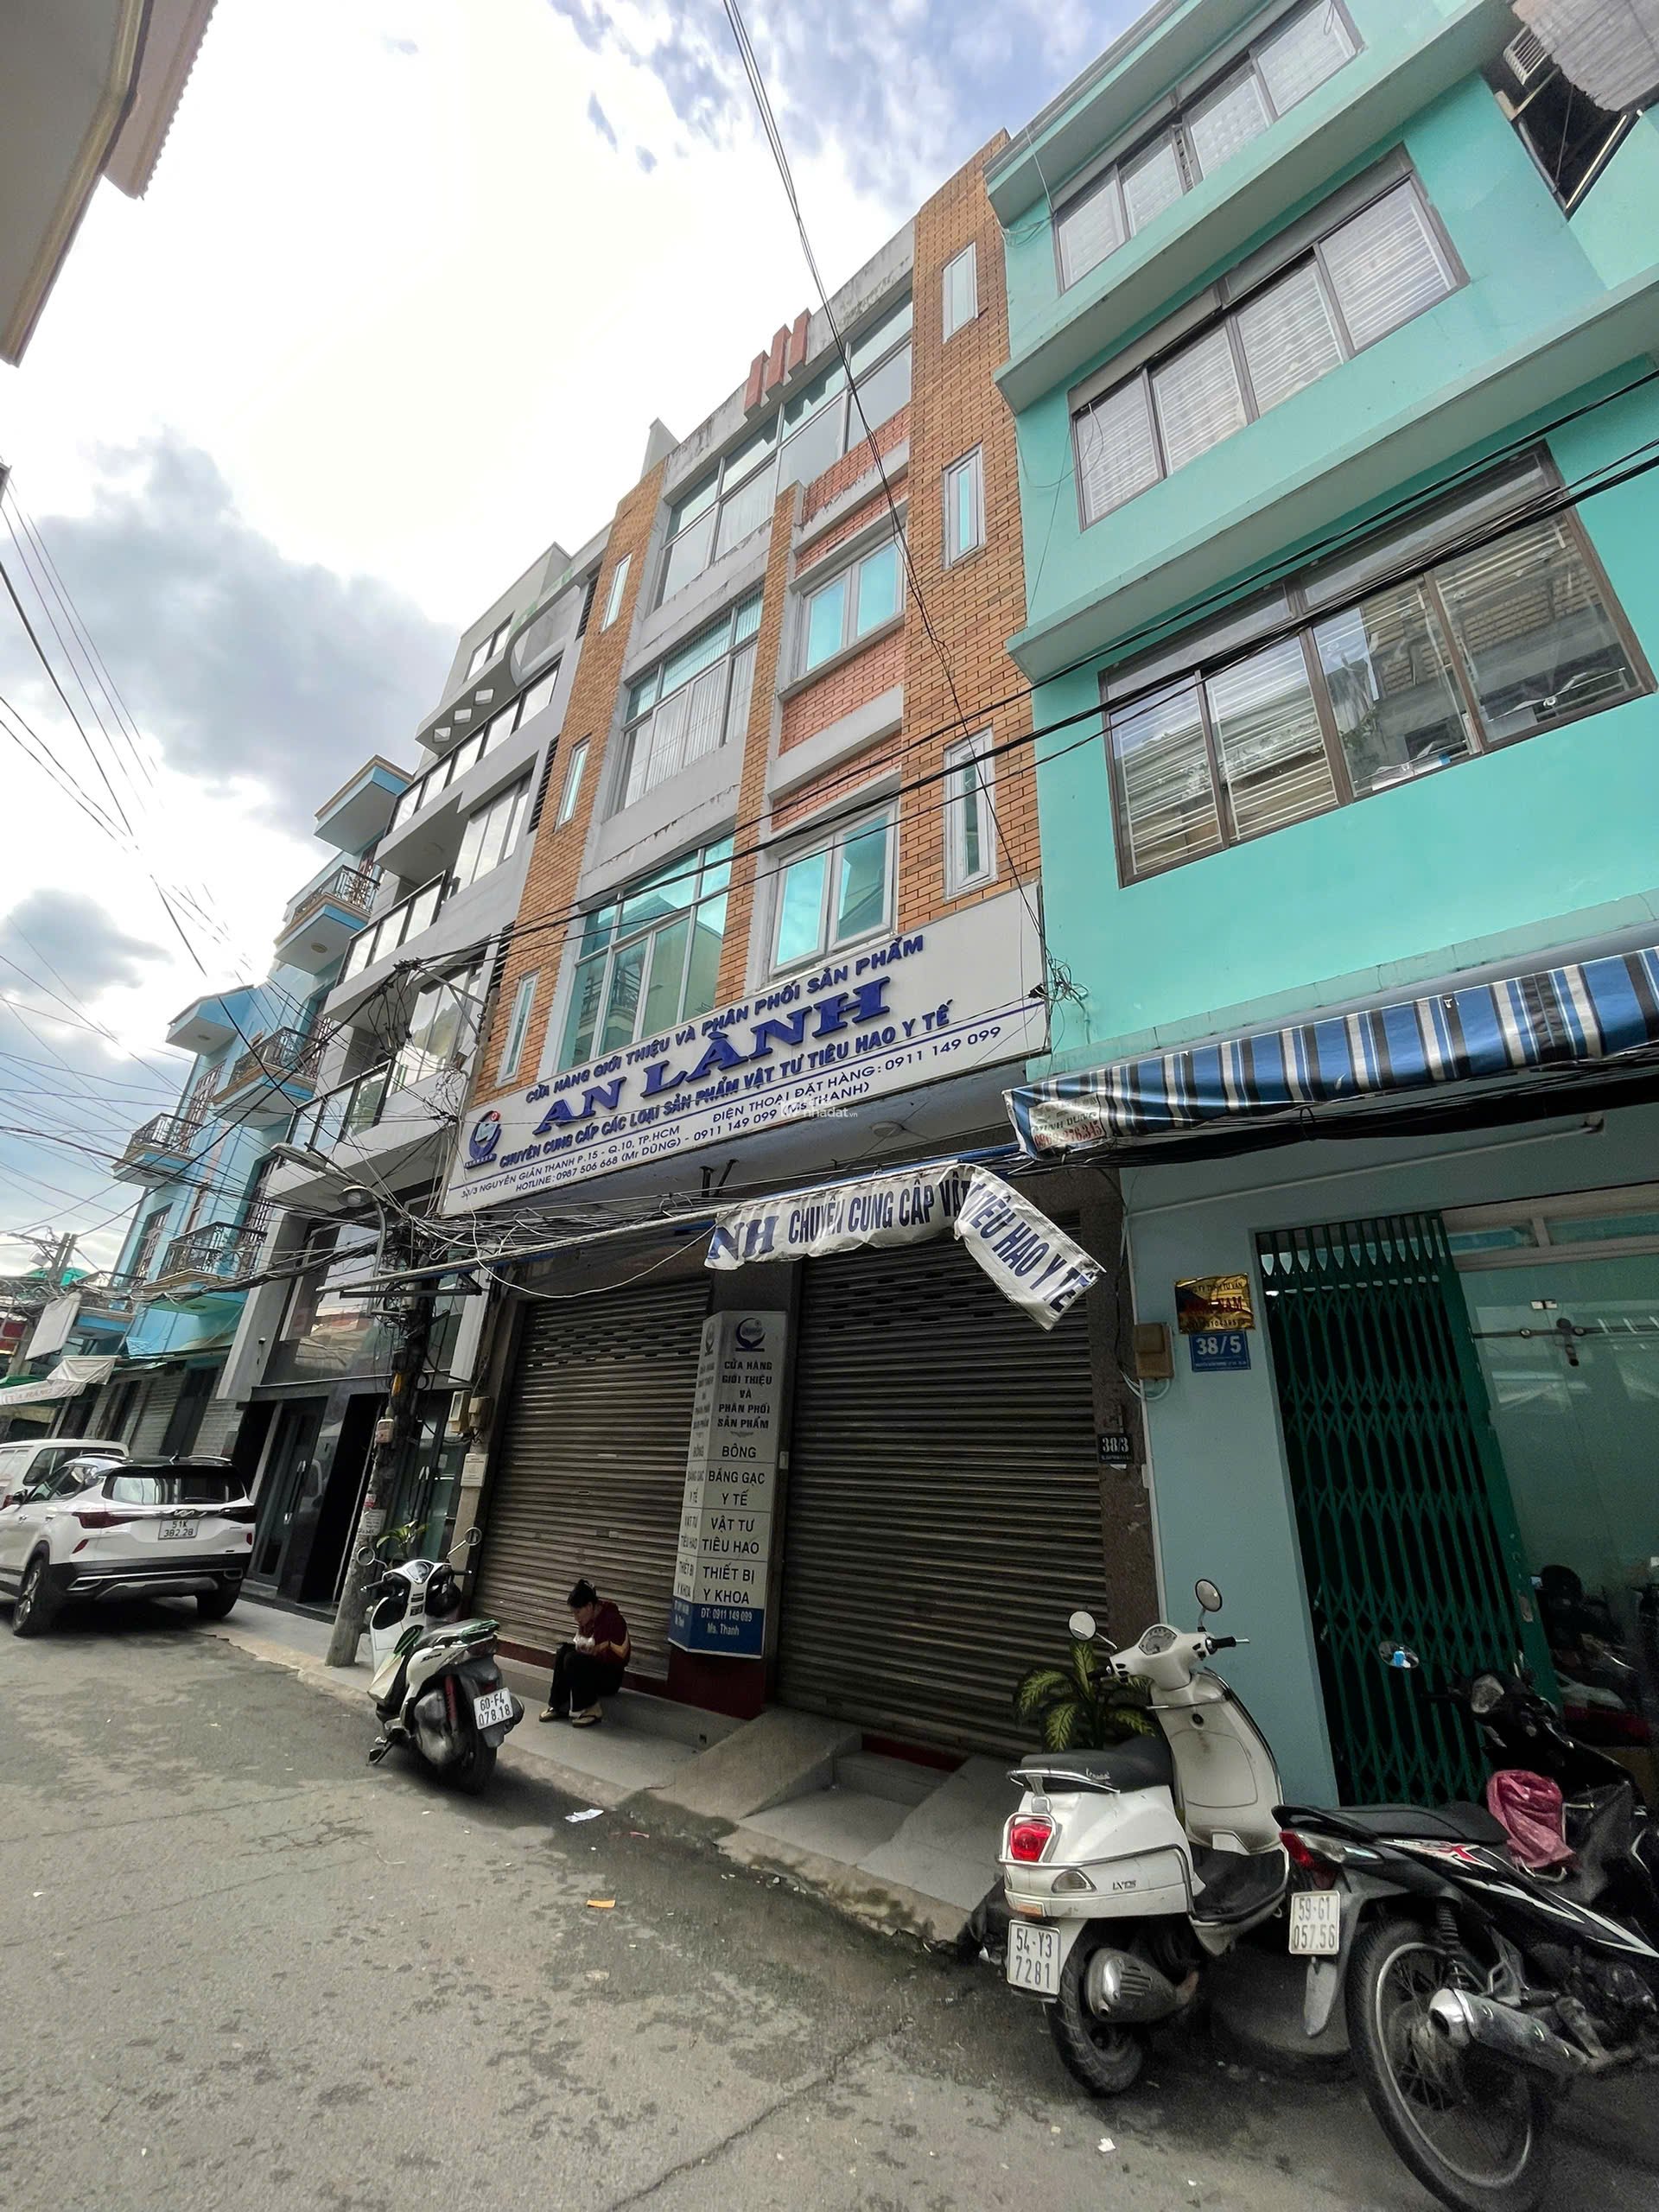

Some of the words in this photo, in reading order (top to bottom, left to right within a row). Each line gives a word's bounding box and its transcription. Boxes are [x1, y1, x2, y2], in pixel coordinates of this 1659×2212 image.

[554, 1069, 591, 1094] HÀNG
[594, 1056, 622, 1077] GIỚI
[626, 1037, 671, 1066] THIỆU
[676, 1026, 696, 1046] VÀ
[701, 1005, 749, 1037] PHÂN
[754, 981, 801, 1015] PHỐI
[807, 965, 849, 995] SẢN
[499, 1145, 542, 1167] CHUYÊN
[543, 1135, 573, 1157] CUNG
[575, 1122, 600, 1145] CẤP
[601, 1114, 627, 1135] CÁC
[630, 1105, 660, 1127] LOẠI
[664, 1093, 692, 1116] SẢN
[695, 1077, 740, 1107] PHẨM
[744, 1066, 775, 1090] VẬT
[780, 1053, 804, 1077] TƯ
[808, 1041, 849, 1069] TIÊU
[855, 1026, 896, 1054] HAO
[902, 1018, 916, 1038] Y
[922, 999, 953, 1031] TẾ
[713, 1105, 745, 1123] ĐIỆN
[749, 1091, 789, 1113] THOẠI
[795, 1081, 823, 1097] ĐẶT
[885, 1051, 922, 1071] 0911
[932, 1039, 962, 1056] 149
[967, 1027, 1001, 1045] 099
[532, 1076, 627, 1135] AN
[544, 1159, 575, 1173] THANH
[576, 1151, 598, 1165] P.15
[639, 1126, 680, 1145] TP.HCM
[556, 1167, 577, 1181] 0987
[580, 1162, 597, 1174] 506
[600, 1154, 618, 1167] 668
[694, 1125, 721, 1141] 0911
[728, 1117, 749, 1131] 149
[753, 1109, 778, 1124] 099
[848, 1191, 894, 1232] CUNG
[991, 1222, 1050, 1277] HAO
[1029, 1253, 1067, 1290] Y
[1196, 1336, 1242, 1356] 38/5
[747, 1360, 772, 1370] HÀNG
[740, 1388, 752, 1399] VÀ
[717, 1415, 738, 1427] SẢN
[721, 1442, 757, 1459] BÔNG
[742, 1471, 766, 1486] GẠC
[721, 1493, 729, 1505] Y
[733, 1489, 749, 1506] TẾ
[172, 1520, 189, 1529] 51K
[711, 1515, 734, 1533] VẬT
[738, 1518, 755, 1532] TƯ
[702, 1536, 729, 1553] TIÊU
[733, 1541, 760, 1554] HAO
[702, 1562, 739, 1580] THIẾT
[742, 1569, 754, 1585] BỊ
[703, 1589, 710, 1601] Y
[715, 1590, 749, 1605] KHOA
[720, 1623, 740, 1636] Thanh
[480, 1696, 505, 1712] 60-F4
[479, 1704, 511, 1726] 078.18
[1294, 1923, 1336, 1949] 057.56
[1016, 1955, 1051, 1989] 7281
